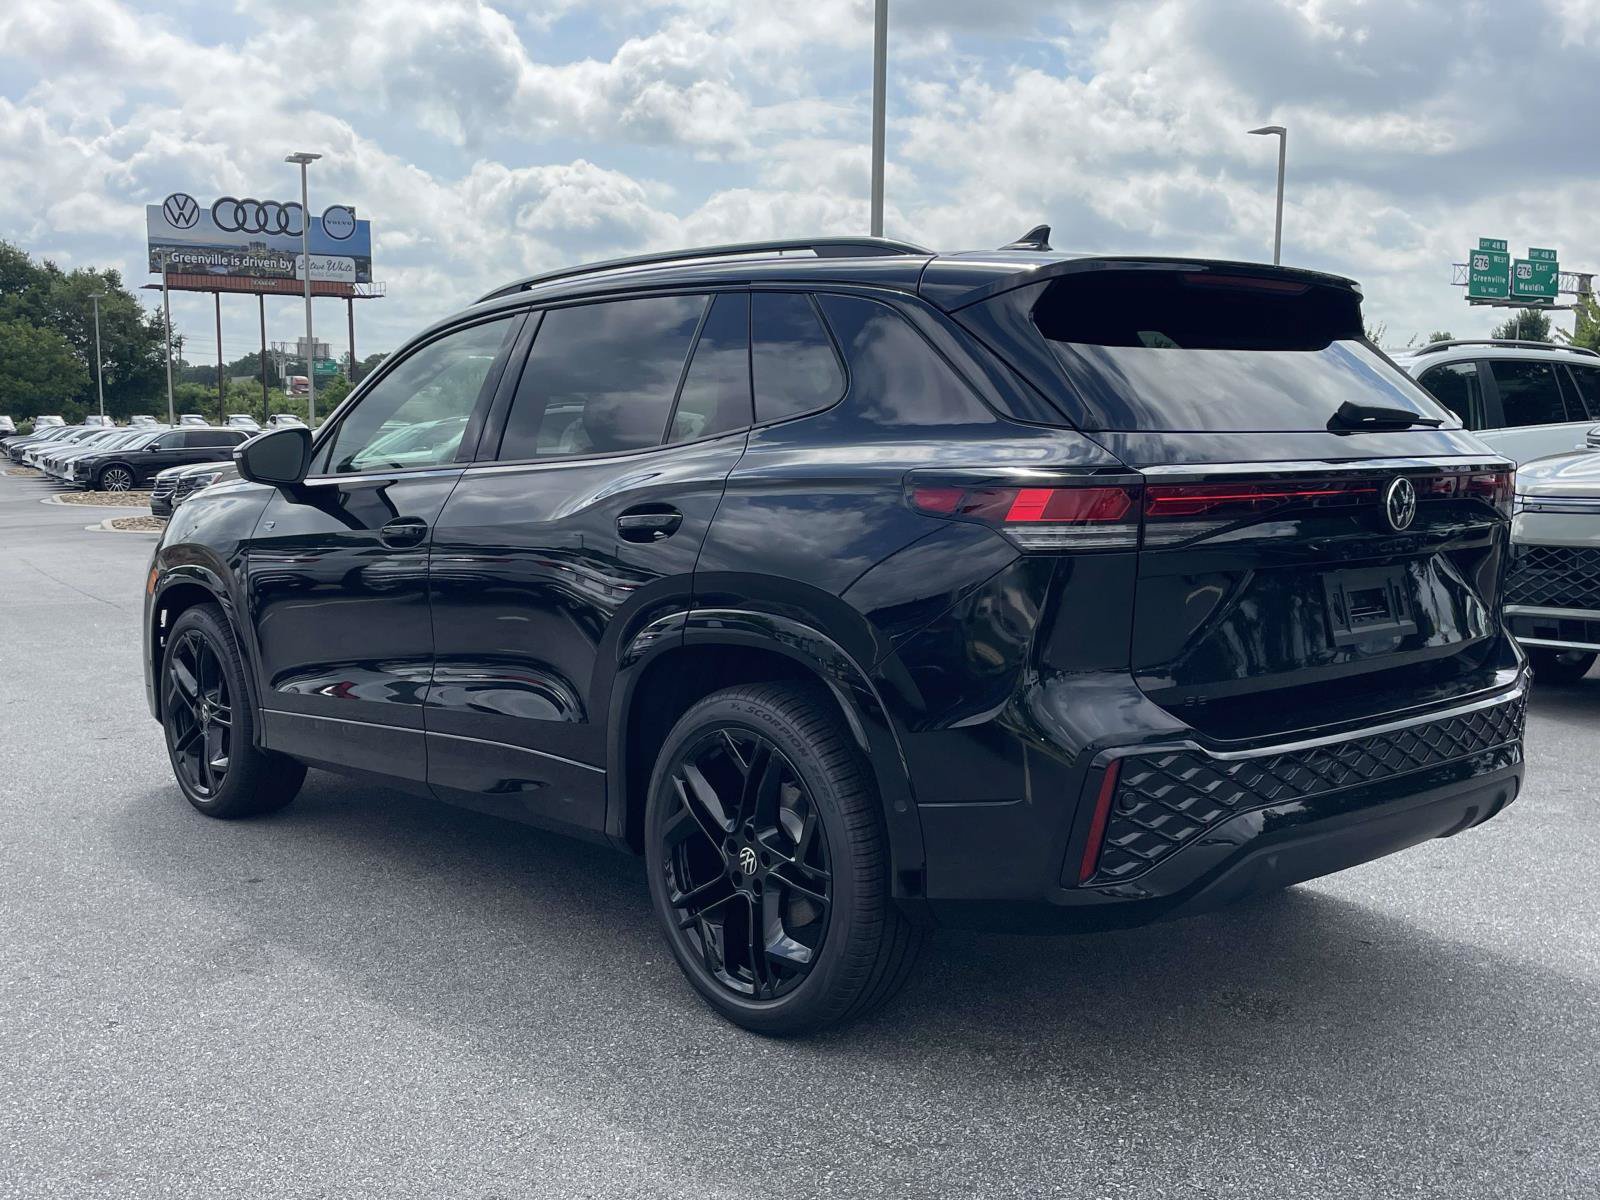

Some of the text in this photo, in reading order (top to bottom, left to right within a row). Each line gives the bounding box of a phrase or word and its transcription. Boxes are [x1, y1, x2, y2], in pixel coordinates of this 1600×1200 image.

[171, 252, 293, 271] Greenville is driven by
[326, 259, 353, 272] White
[1474, 256, 1507, 268] 276 WEST
[1517, 263, 1548, 277] 276 EAST
[1473, 274, 1507, 284] Greenville
[1519, 282, 1545, 292] Mauldin
[745, 705, 809, 758] SCORPION
